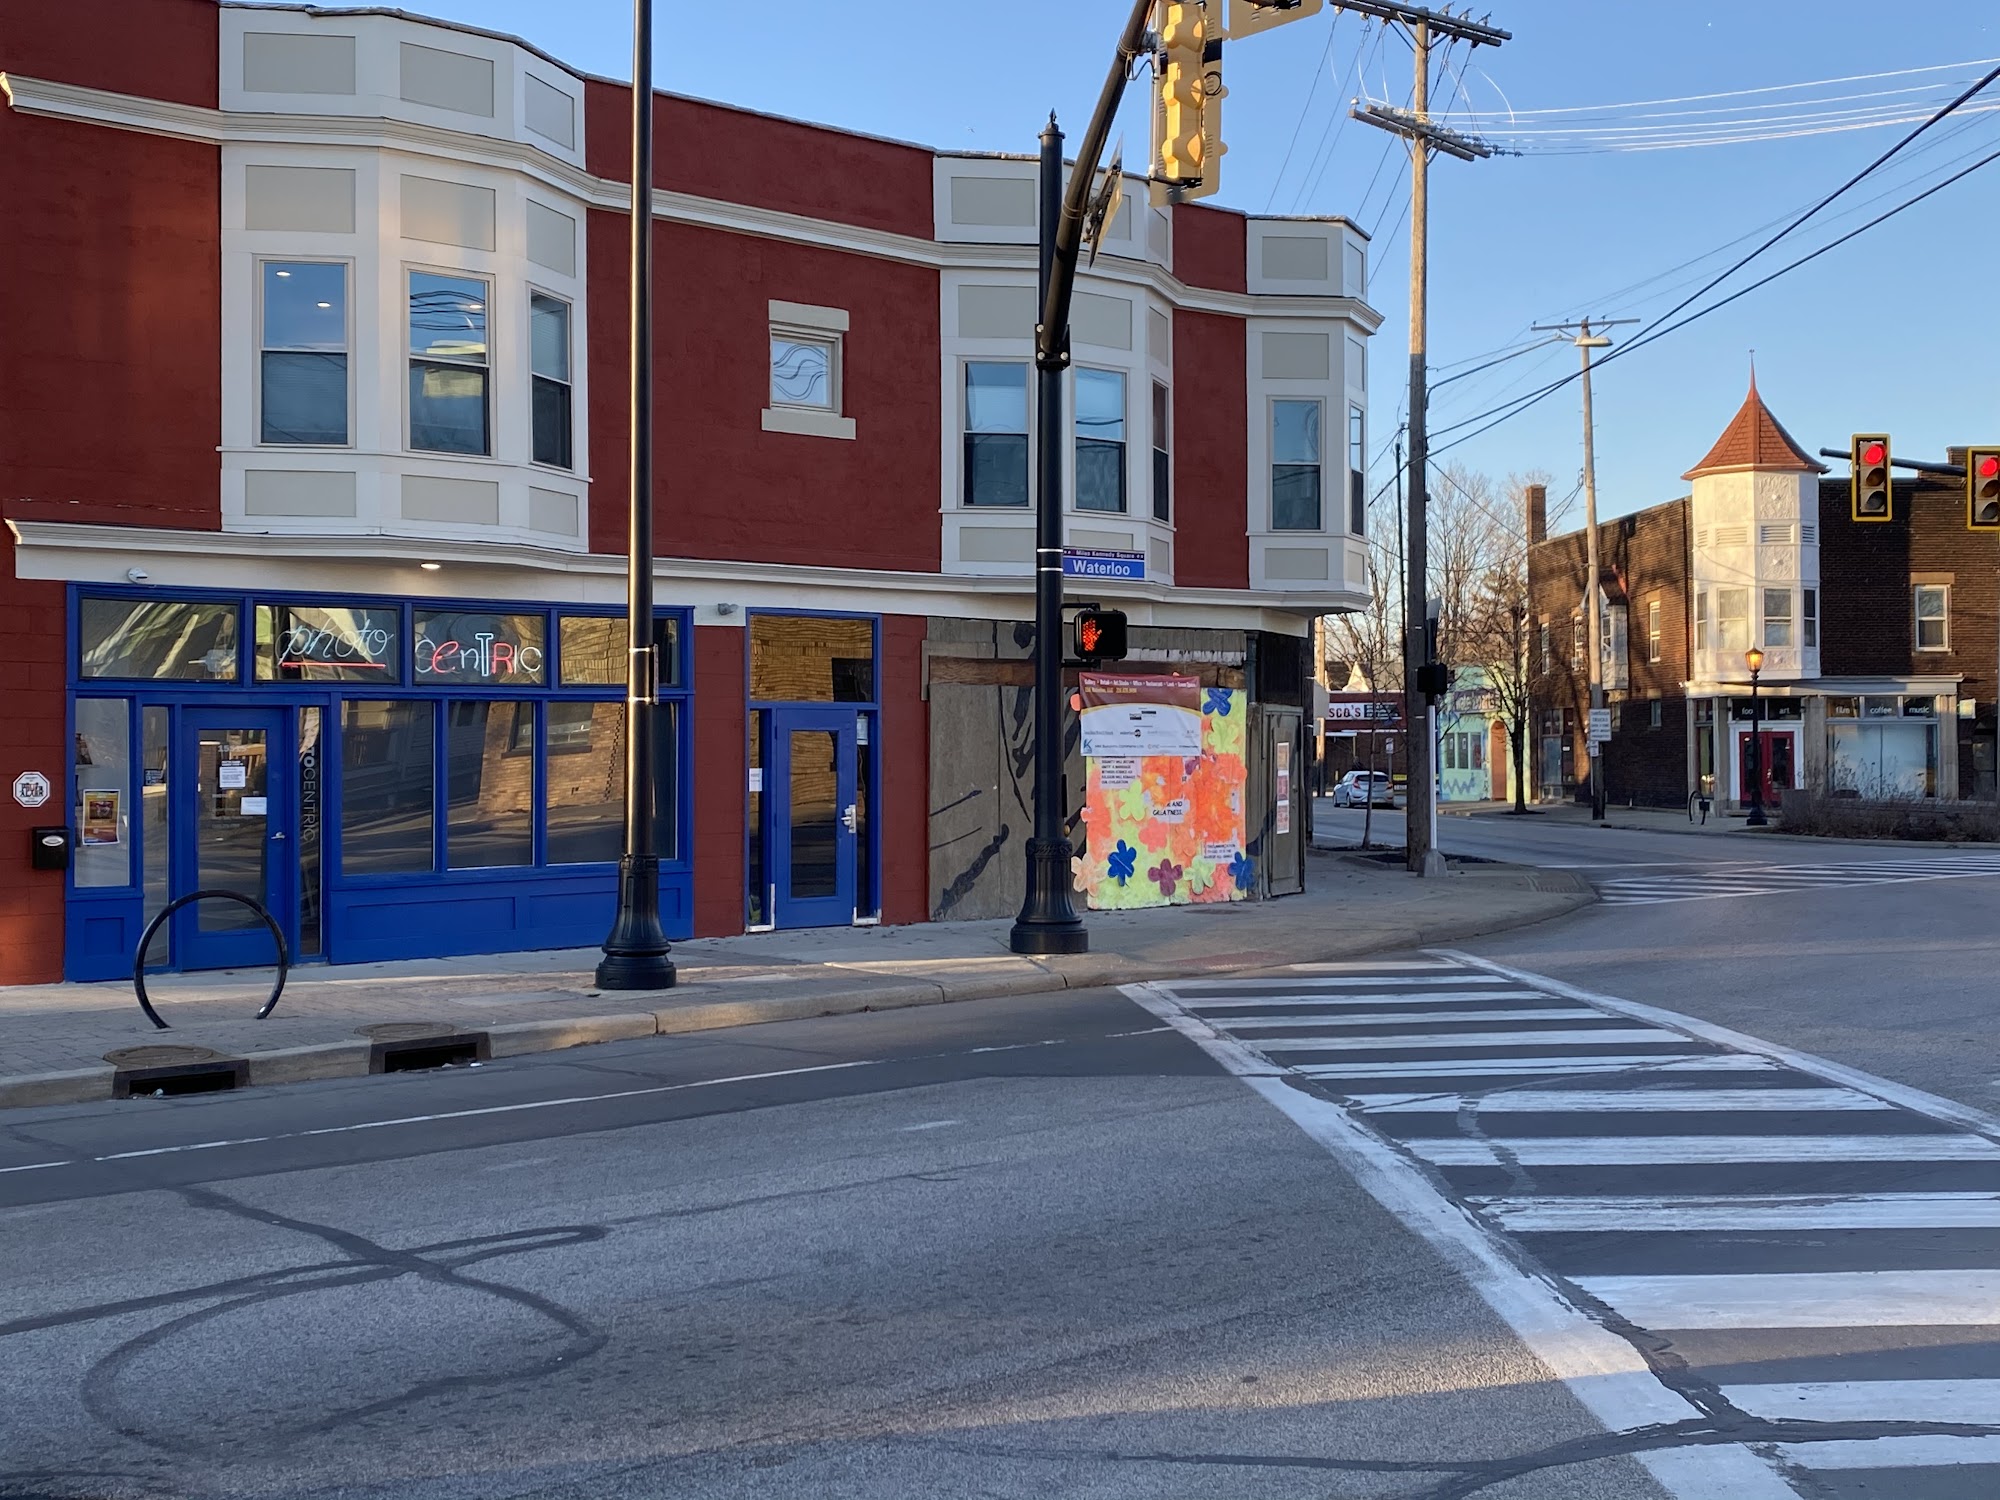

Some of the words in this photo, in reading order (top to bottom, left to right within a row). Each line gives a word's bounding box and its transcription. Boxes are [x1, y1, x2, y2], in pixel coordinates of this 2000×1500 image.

[1072, 560, 1130, 576] Waterloo
[276, 618, 394, 667] photo
[1778, 707, 1791, 716] art
[1835, 705, 1851, 715] film
[1869, 705, 1893, 715] coffee
[1908, 705, 1931, 715] music
